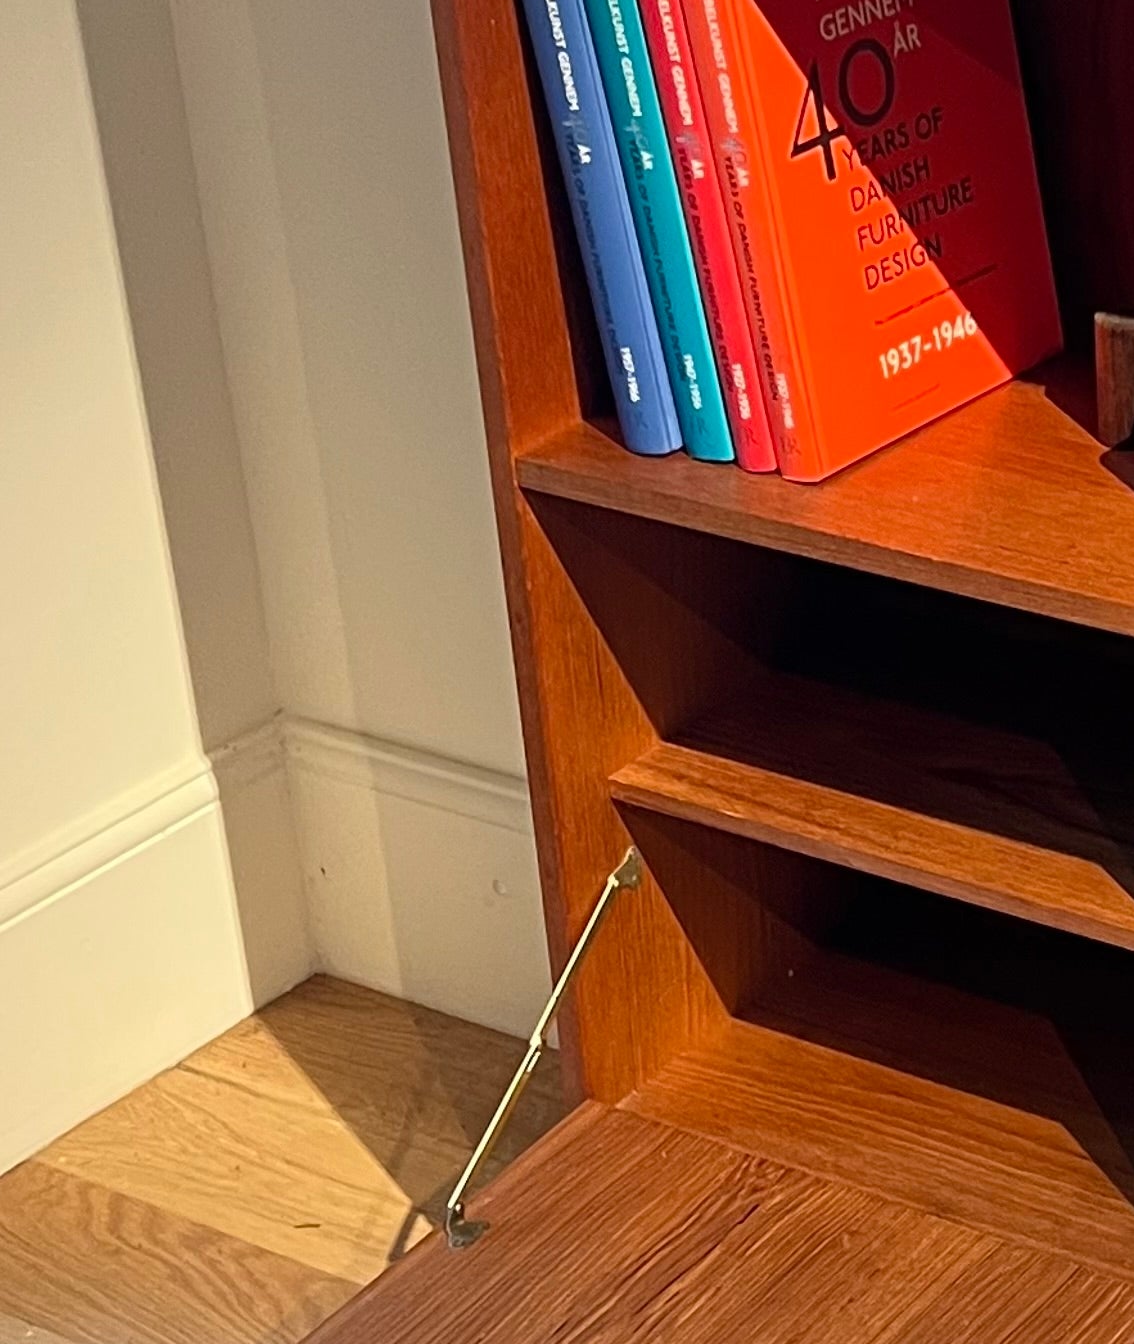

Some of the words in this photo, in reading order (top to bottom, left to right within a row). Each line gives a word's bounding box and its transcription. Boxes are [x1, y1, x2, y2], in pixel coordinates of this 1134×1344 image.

[557, 52, 580, 111] GENNEM
[621, 57, 642, 116] GENNEM
[671, 65, 693, 126] GENNEM
[718, 72, 739, 134] GENNEM
[791, 38, 895, 180] 40
[893, 20, 921, 58] ÅR
[842, 124, 909, 171] YEARS
[914, 107, 943, 140] OF
[687, 193, 698, 212] OF
[726, 156, 740, 199] YEARS
[733, 201, 744, 221] OF
[850, 157, 930, 212] DANISH
[857, 176, 974, 251] FURNITURE
[864, 233, 942, 290] DESIGN
[879, 311, 977, 379] 1937-1946
